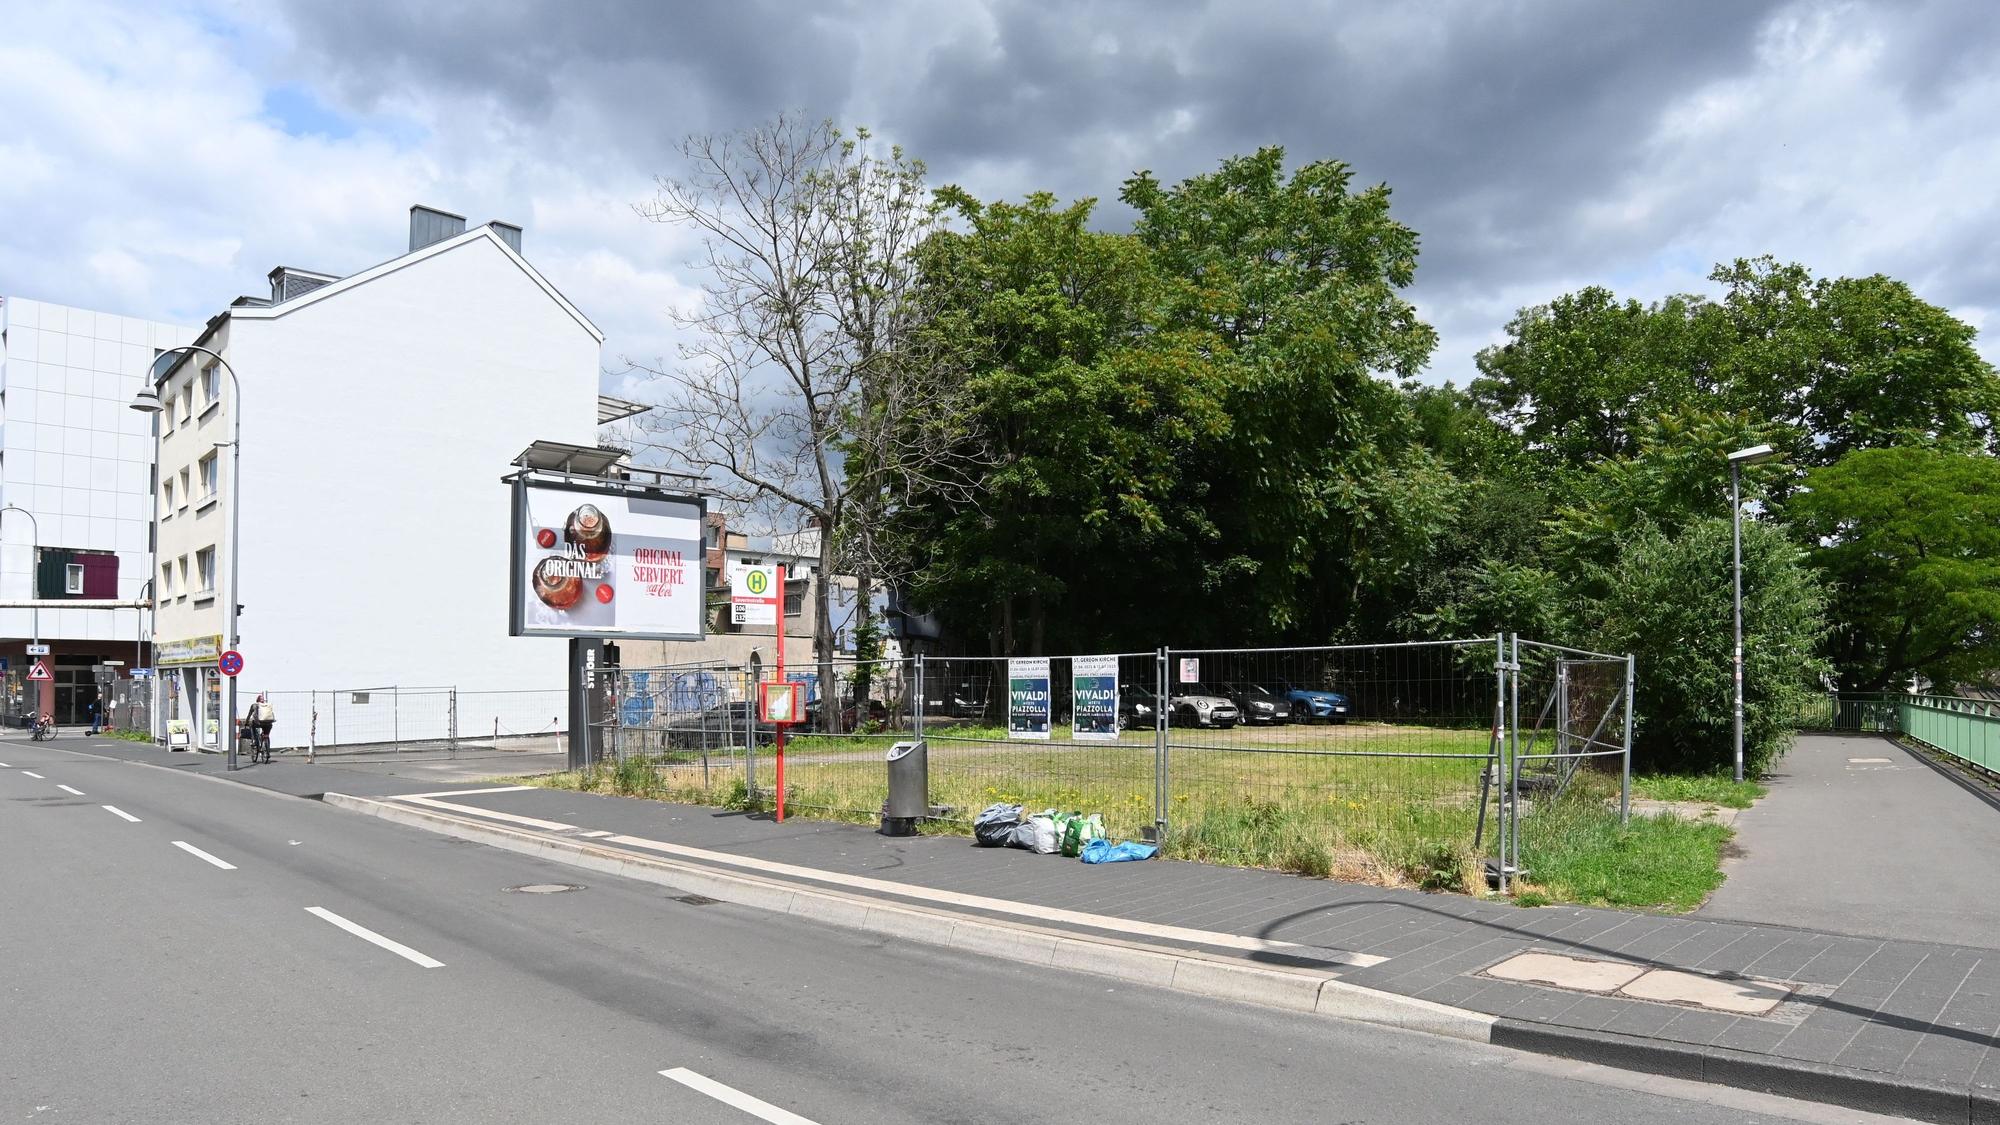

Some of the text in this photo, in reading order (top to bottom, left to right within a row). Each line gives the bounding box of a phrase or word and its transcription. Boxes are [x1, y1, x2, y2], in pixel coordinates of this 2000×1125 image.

[564, 542, 586, 560] DAS
[635, 547, 684, 567] ORIGINAL
[633, 566, 684, 585] SERVIERT.
[1011, 690, 1047, 700] VIVALDI
[1075, 689, 1113, 699] VIVALDI
[1012, 705, 1047, 713] PIAZZOLLA
[1076, 705, 1113, 713] PIAZZOLLA
